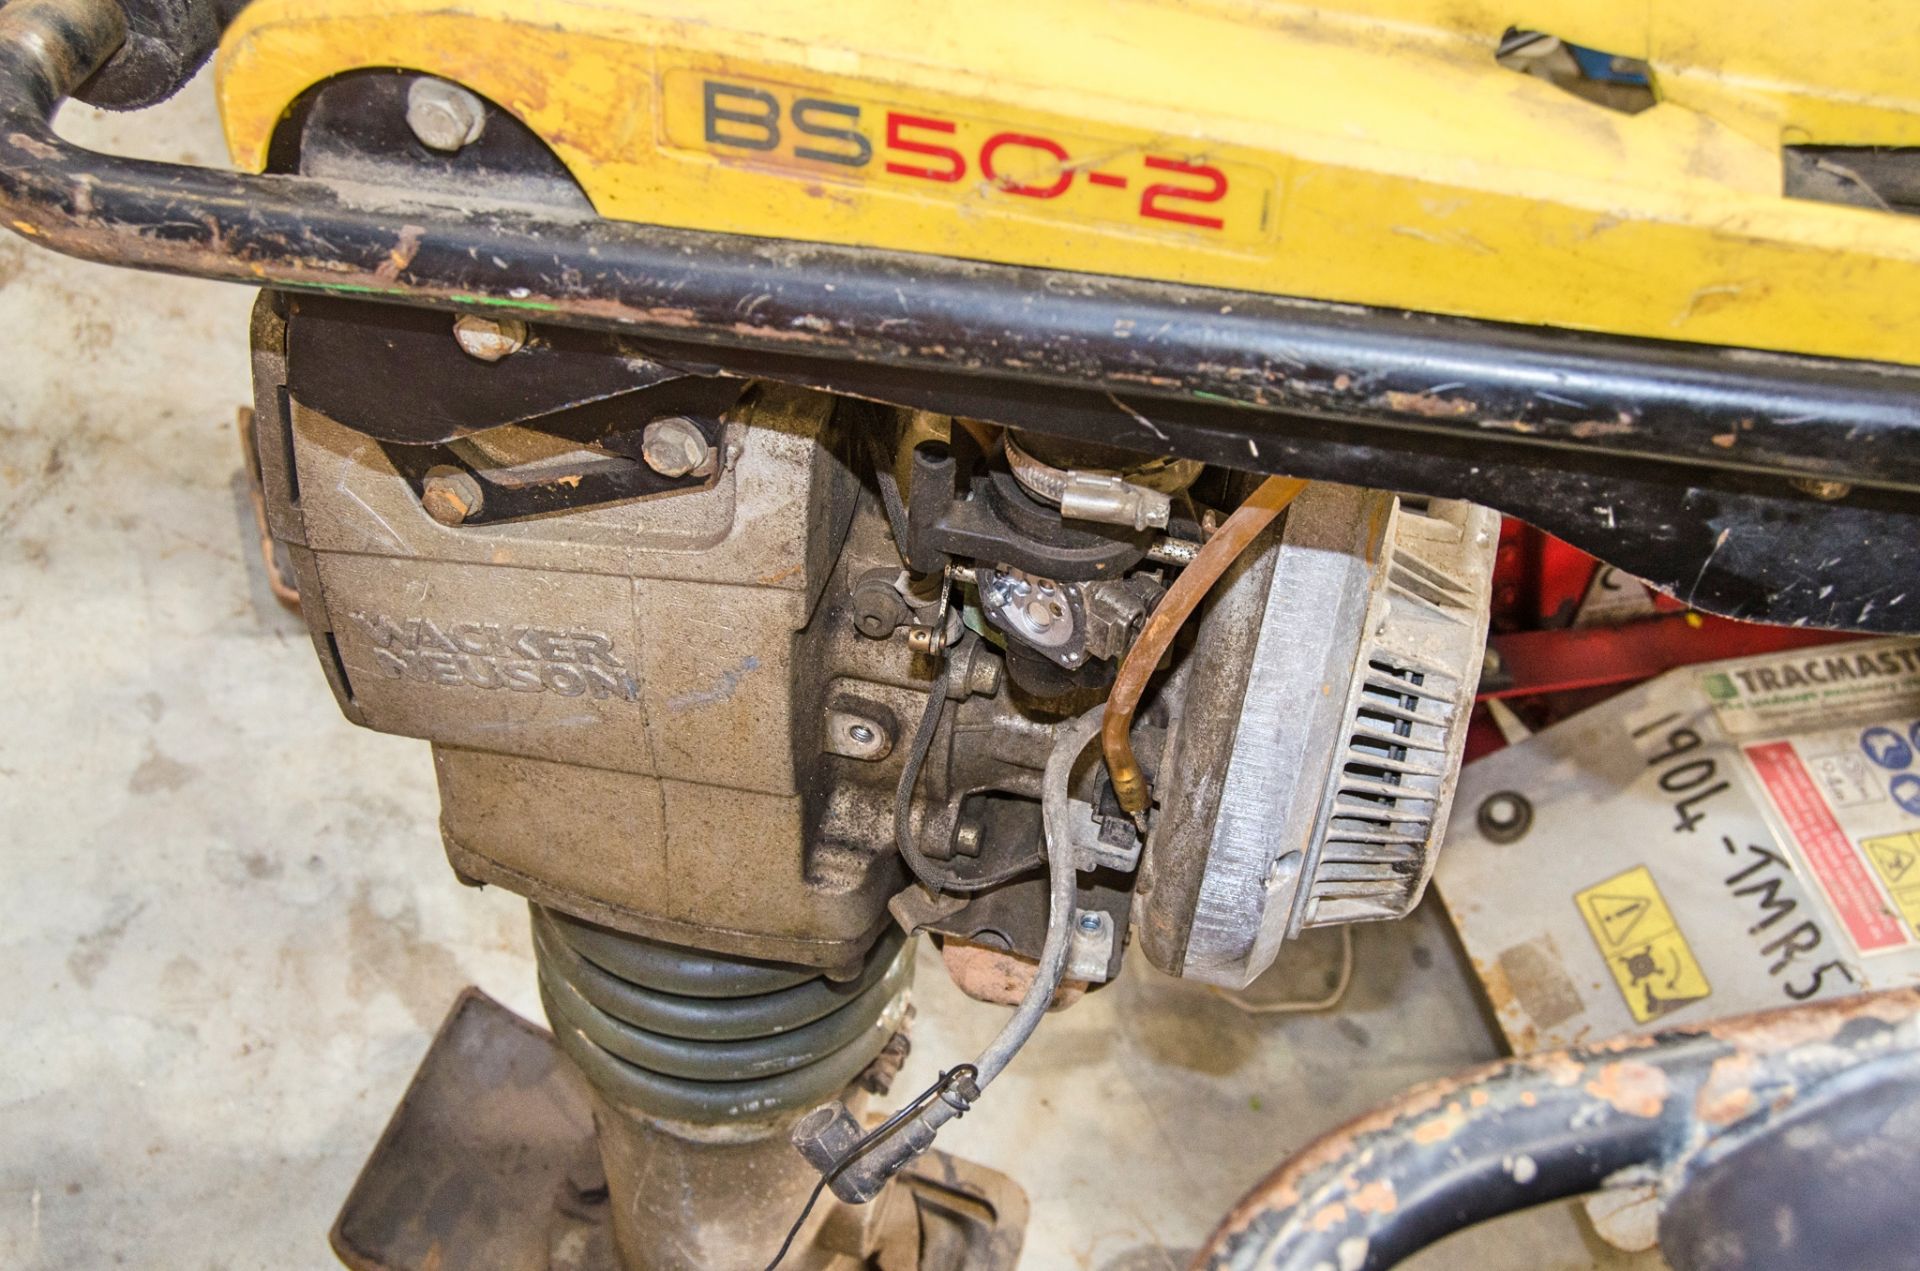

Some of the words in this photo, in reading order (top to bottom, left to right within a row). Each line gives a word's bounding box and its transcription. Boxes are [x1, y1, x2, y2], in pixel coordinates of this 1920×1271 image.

[702, 80, 1229, 230] BS50-2
[348, 610, 625, 668] WACKER
[372, 647, 638, 702] NEUSON
